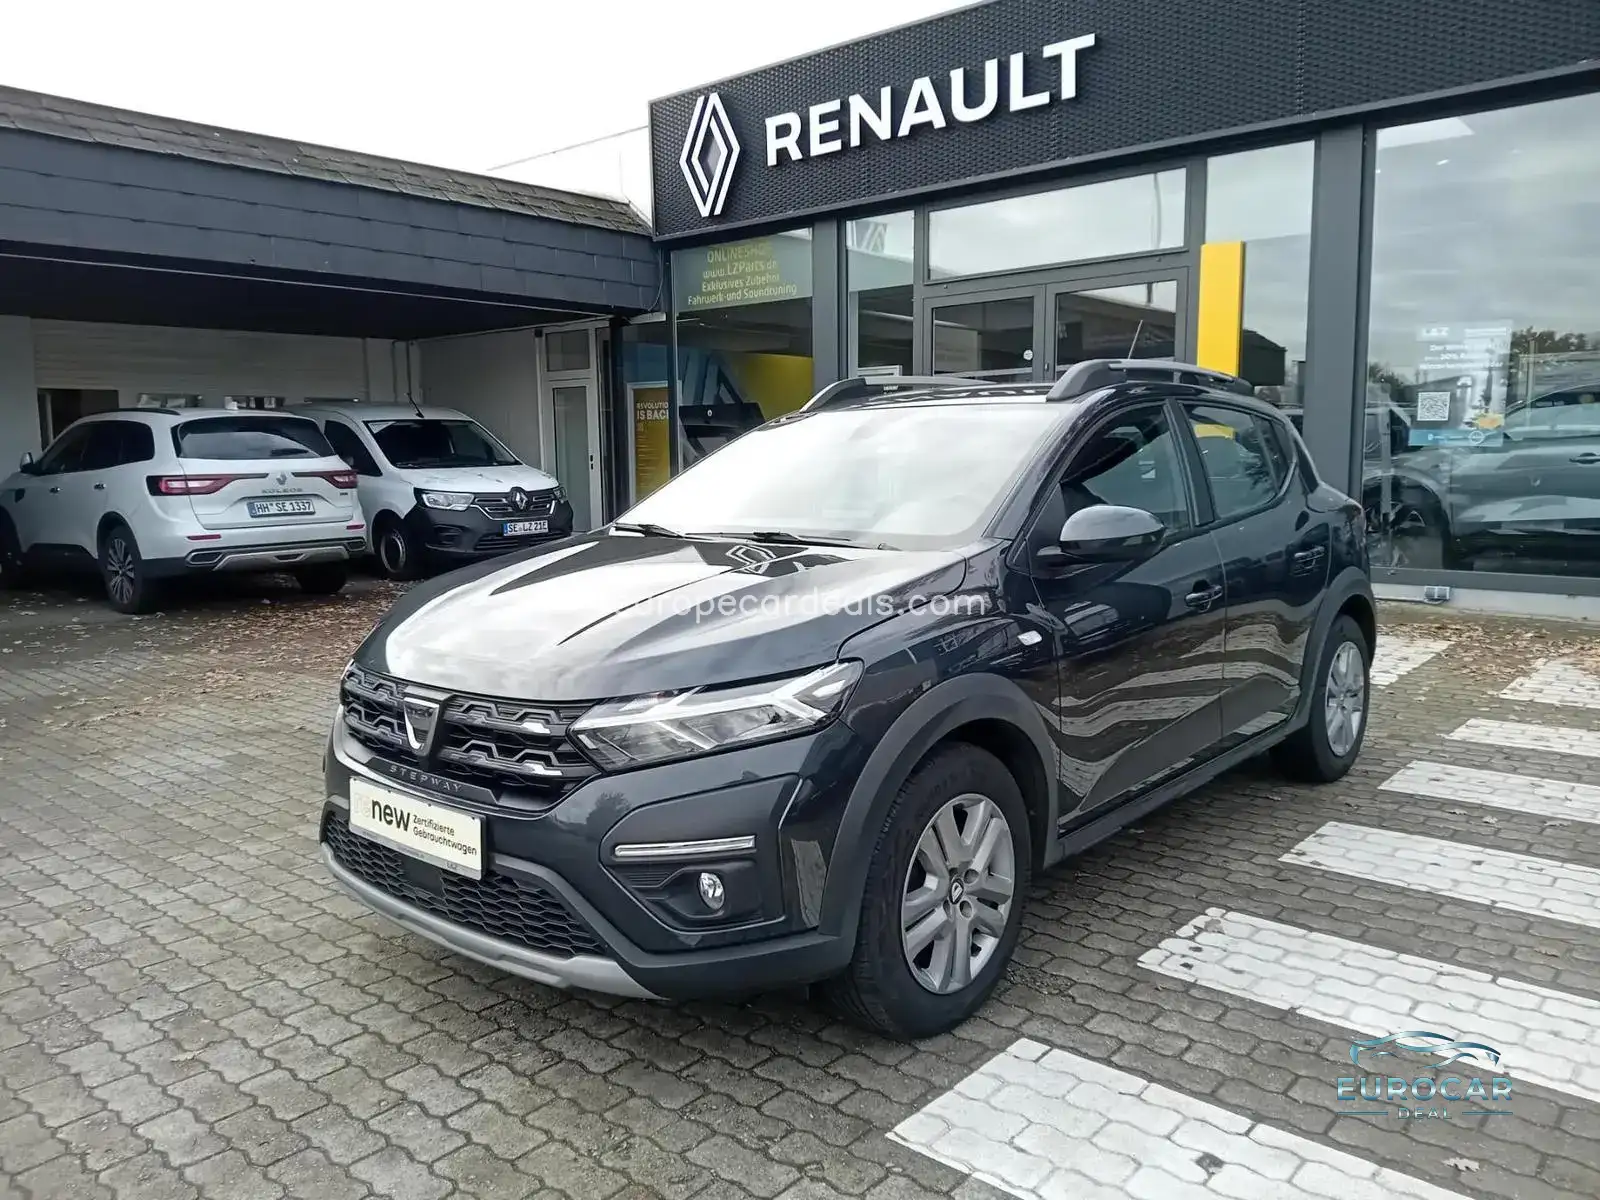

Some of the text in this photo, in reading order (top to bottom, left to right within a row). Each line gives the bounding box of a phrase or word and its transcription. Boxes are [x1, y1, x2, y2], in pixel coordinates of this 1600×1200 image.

[765, 33, 1095, 167] RENAULT
[707, 242, 771, 263] ONLINESHO
[702, 278, 744, 292] Exklusives
[744, 283, 797, 299] Soundtuning
[636, 401, 669, 410] REVOLUTIO
[637, 410, 646, 420] IS
[256, 501, 312, 514] HH SE 1337
[508, 523, 518, 532] SE
[389, 764, 462, 792] STEPWAY
[413, 814, 455, 836] Zertifizierte
[413, 826, 477, 855] Gebrauchtwagen
